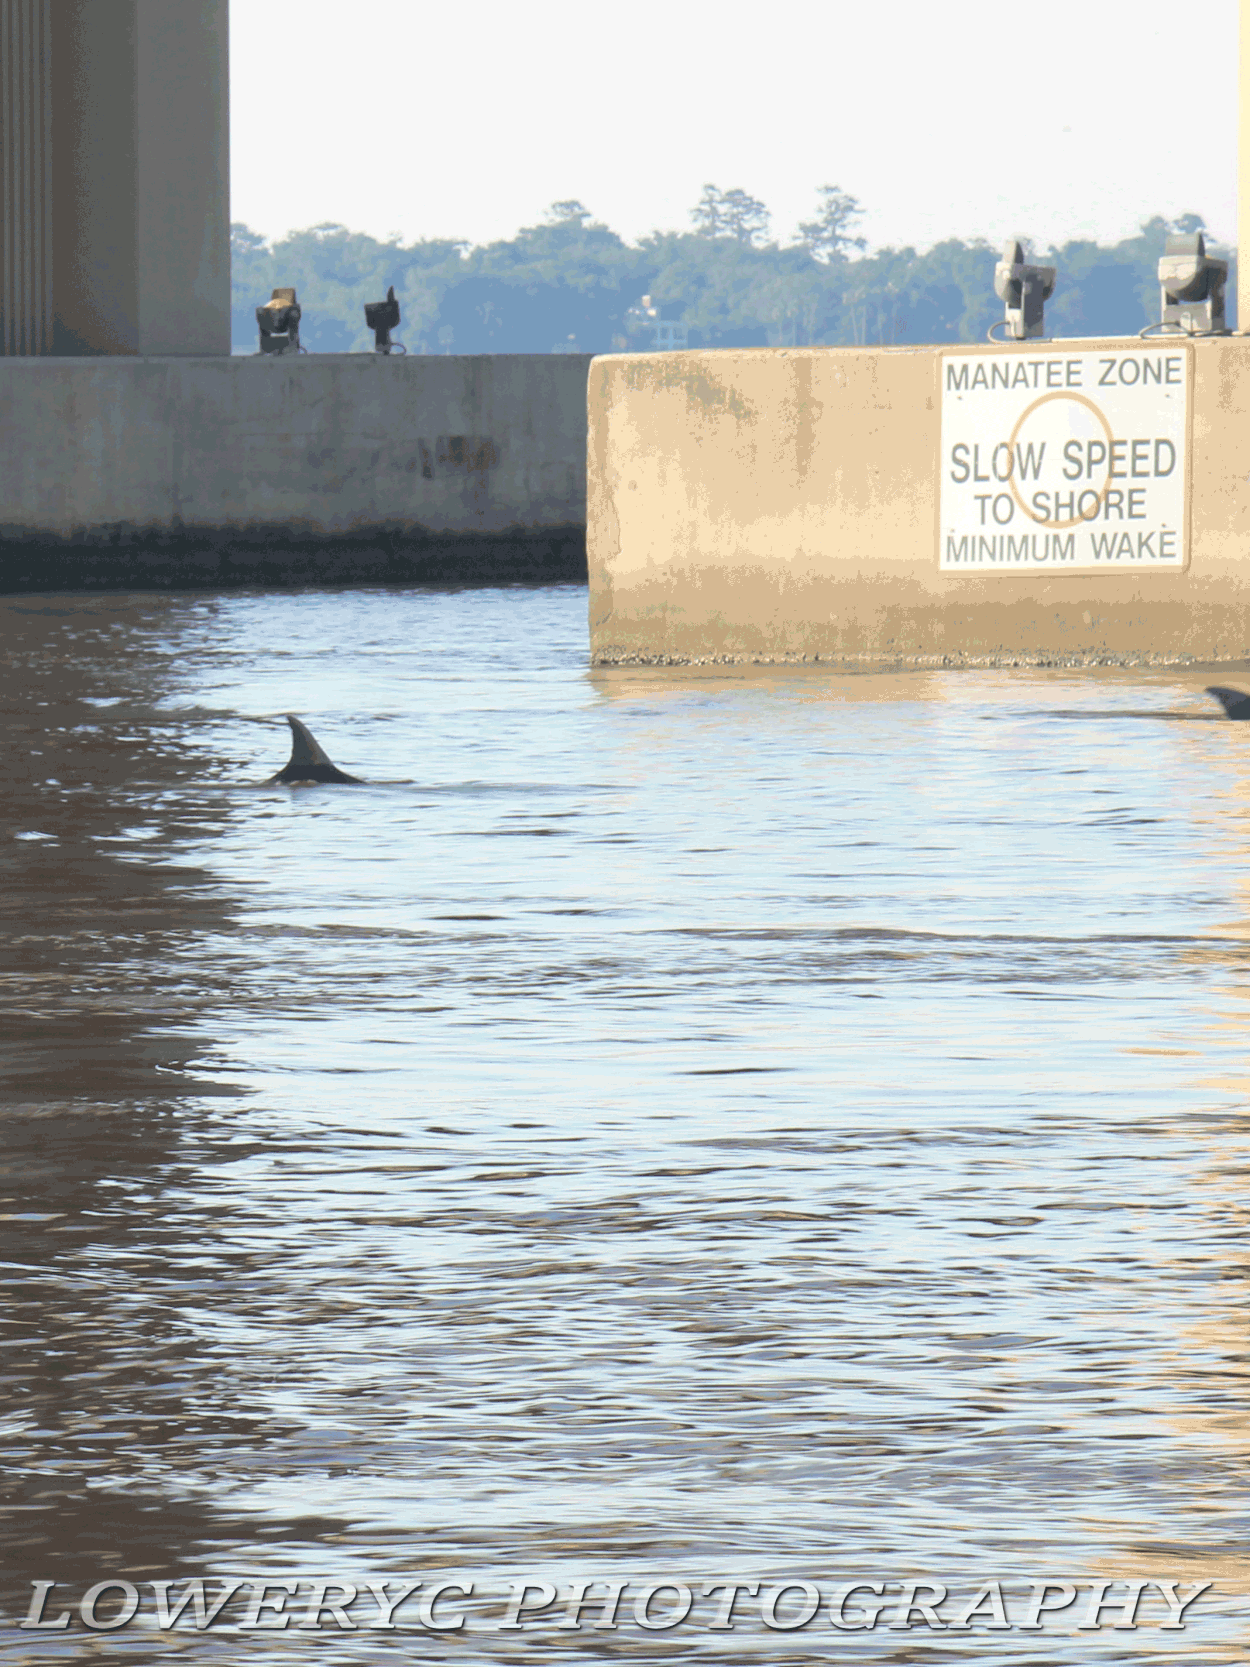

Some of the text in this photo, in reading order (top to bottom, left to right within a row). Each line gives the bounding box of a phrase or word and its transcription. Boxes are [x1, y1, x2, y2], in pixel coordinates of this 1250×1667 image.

[946, 356, 1182, 391] MANATEE ZONE
[950, 438, 1177, 484] SLOW SPEED
[973, 488, 1147, 525] TO SHORE
[946, 530, 1177, 562] MINIMUM WAKE
